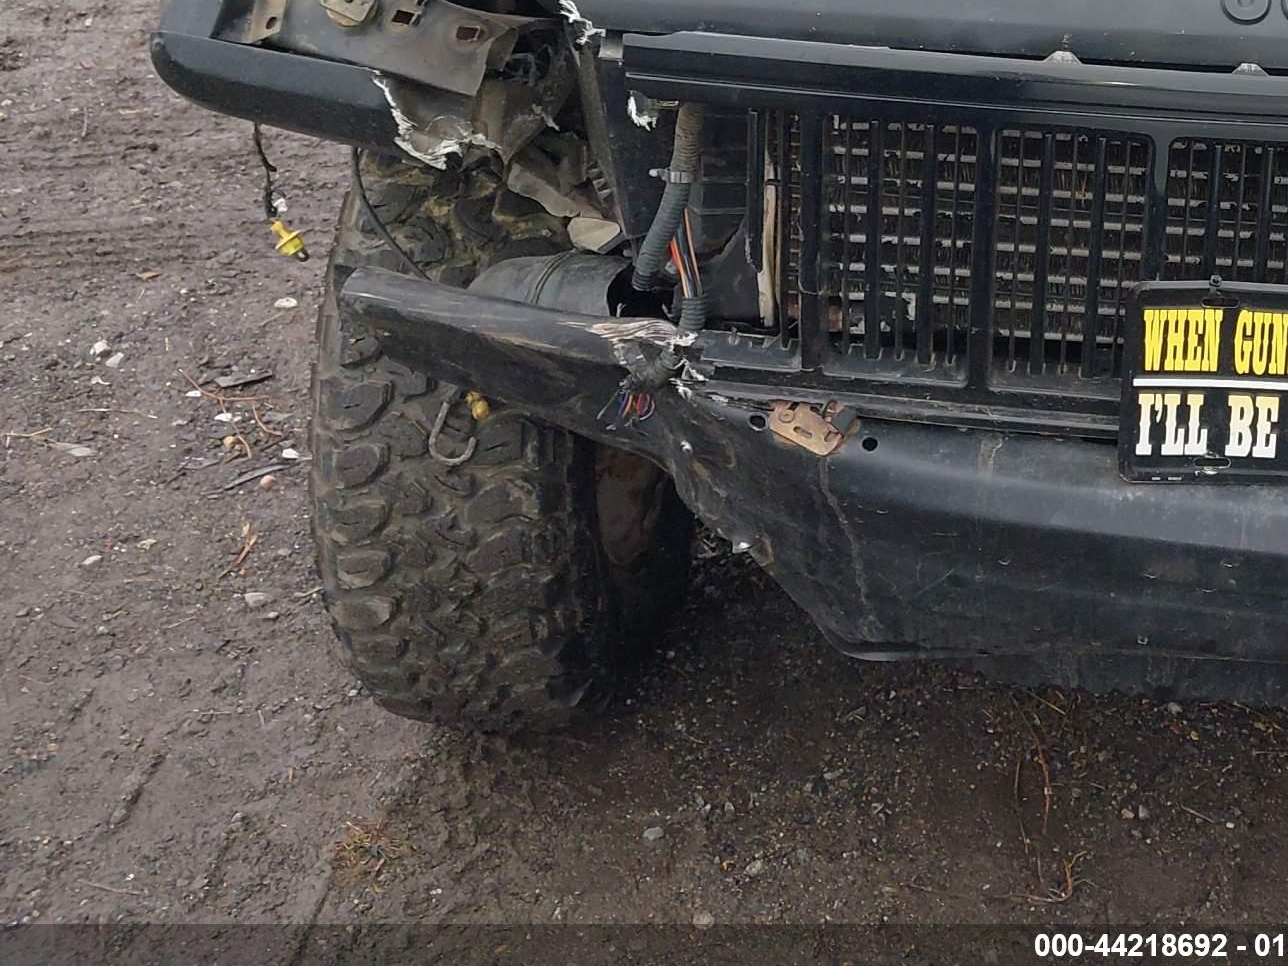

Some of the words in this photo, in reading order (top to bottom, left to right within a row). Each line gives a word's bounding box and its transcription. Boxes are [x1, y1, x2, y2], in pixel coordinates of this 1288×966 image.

[1143, 307, 1224, 372] WHEN
[1135, 392, 1208, 457] I'LL
[1224, 394, 1280, 460] BE
